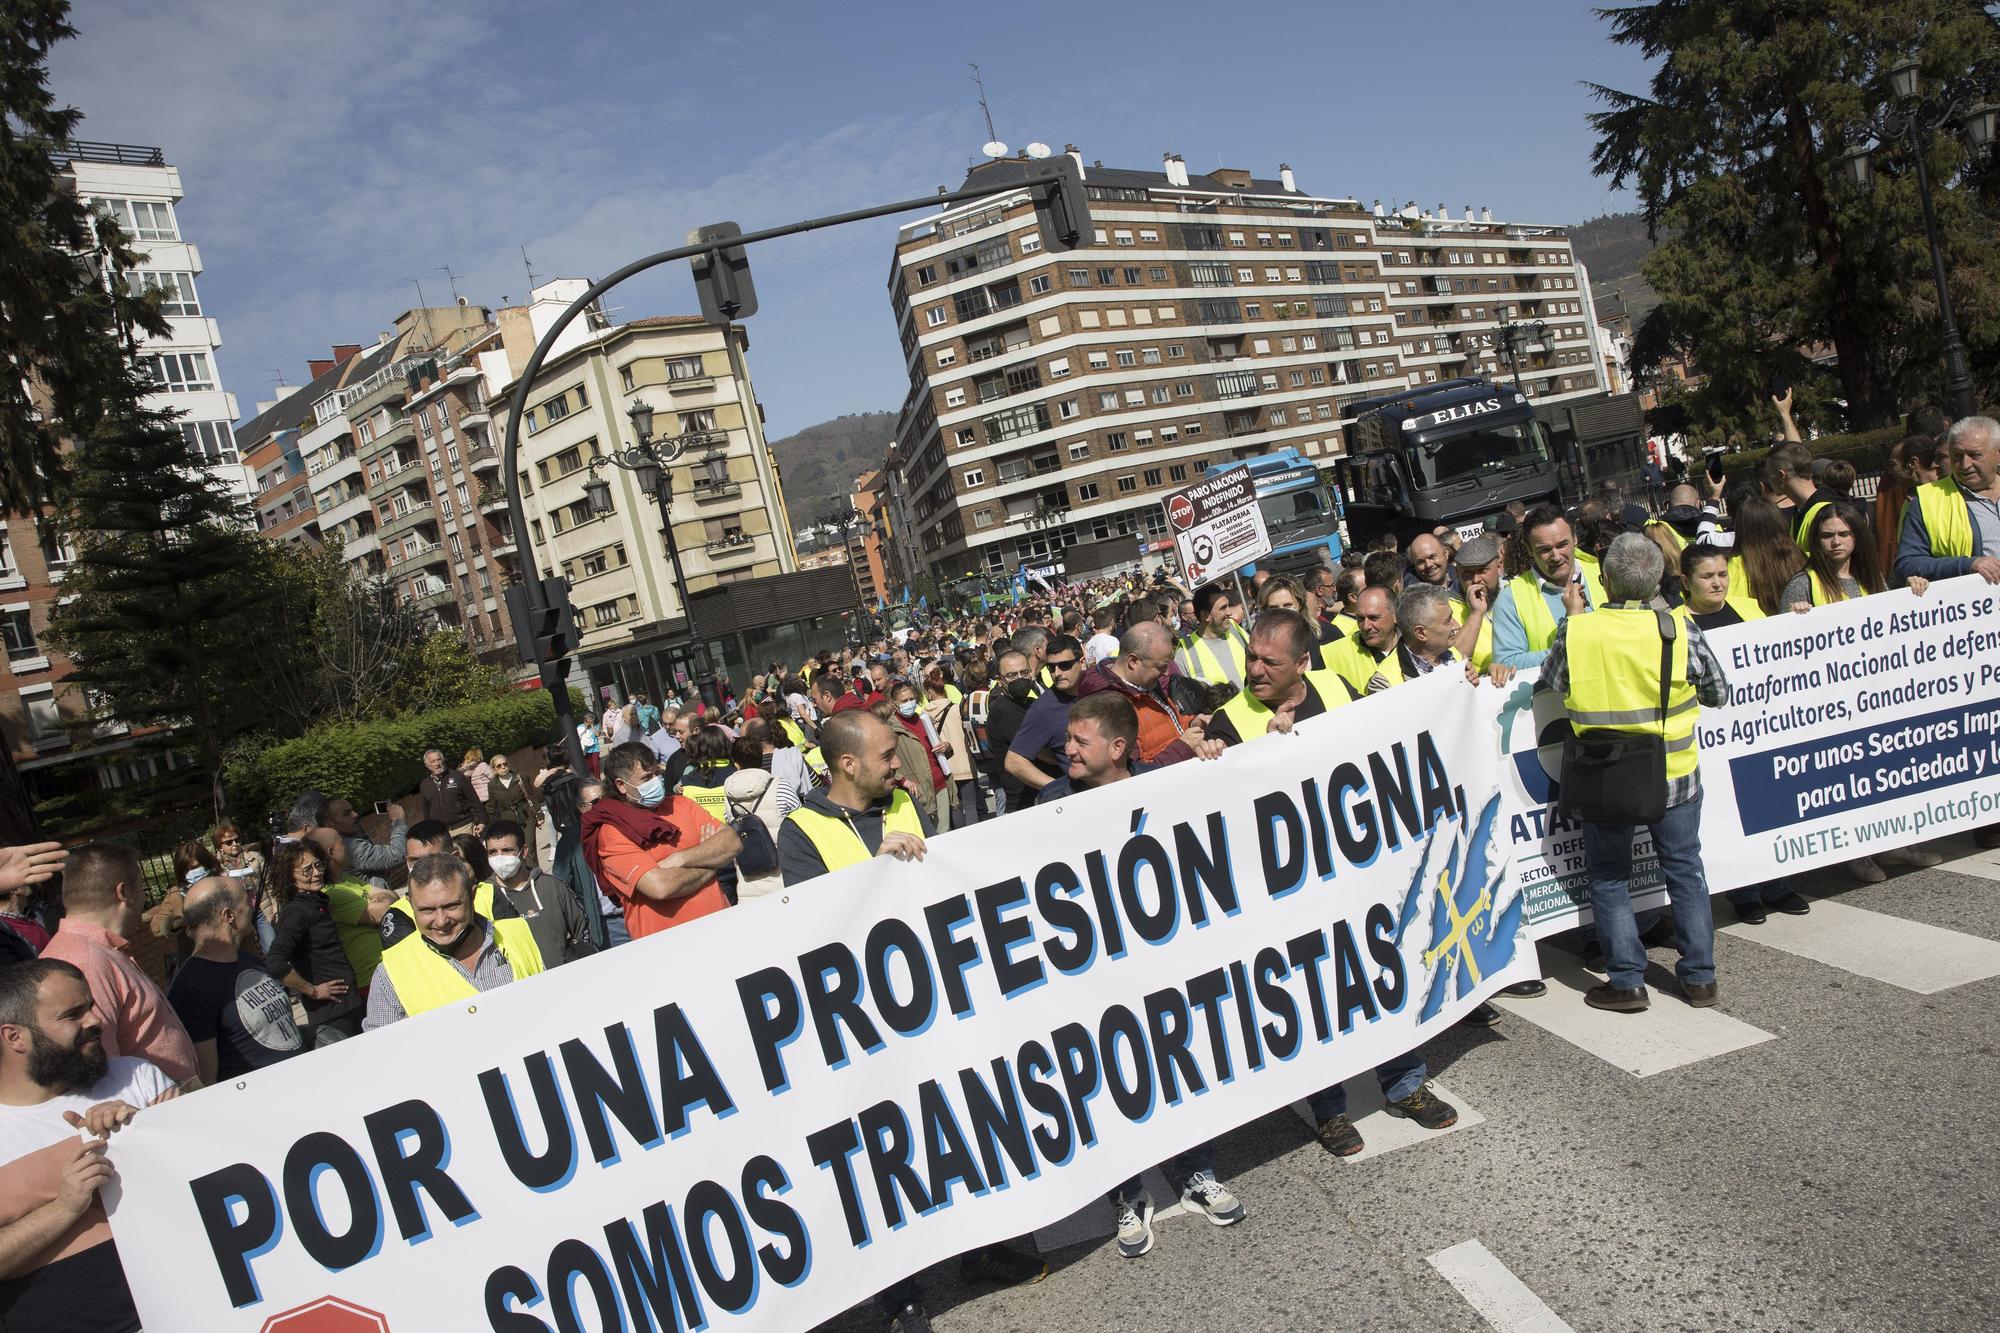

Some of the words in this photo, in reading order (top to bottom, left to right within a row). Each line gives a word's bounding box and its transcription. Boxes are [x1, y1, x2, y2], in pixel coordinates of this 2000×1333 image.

[1431, 398, 1501, 425] ELIAS
[1187, 485, 1210, 502] PARO
[1209, 468, 1249, 492] NACIONAL
[1201, 485, 1244, 510] INDEFINIDO
[1172, 505, 1191, 520] STOP
[1227, 501, 1234, 510] 14
[1236, 494, 1253, 506] Marzo
[1211, 509, 1251, 532] PLATAFORMA
[1732, 644, 1751, 670] El
[1754, 625, 1856, 665] transporte
[1861, 616, 1884, 642] de
[1889, 599, 1967, 636] Asturias
[1972, 598, 1993, 617] se
[1728, 670, 1822, 707] lataforma
[1827, 644, 1908, 685] Nacional
[1914, 639, 1937, 665] de
[1698, 726, 1726, 750] los
[1731, 698, 1853, 746] Agricultores,
[1857, 674, 1959, 714] Ganaderos
[1963, 671, 1975, 696] y
[1773, 753, 1808, 780] Por
[1815, 738, 1864, 770] unos
[1869, 719, 1959, 757] Sectores
[1797, 786, 1847, 819] para
[1850, 773, 1871, 799] la
[1876, 746, 1969, 792] Sociedad
[1972, 748, 1987, 776] y
[1773, 826, 1849, 864] ÚNETE:
[1530, 875, 1590, 901] MERCANCIAS
[1528, 894, 1573, 915] NACIONAL
[241, 979, 284, 1010] HILFIGE
[261, 995, 290, 1025] DENIM
[189, 1098, 482, 1309] POR
[477, 1001, 738, 1193] UNA
[735, 806, 1242, 1096] PROFESIÓN
[1254, 729, 1469, 900] DIGNA,
[484, 1154, 812, 1333] SOMOS
[806, 902, 1409, 1248] TRANSPORTISTAS
